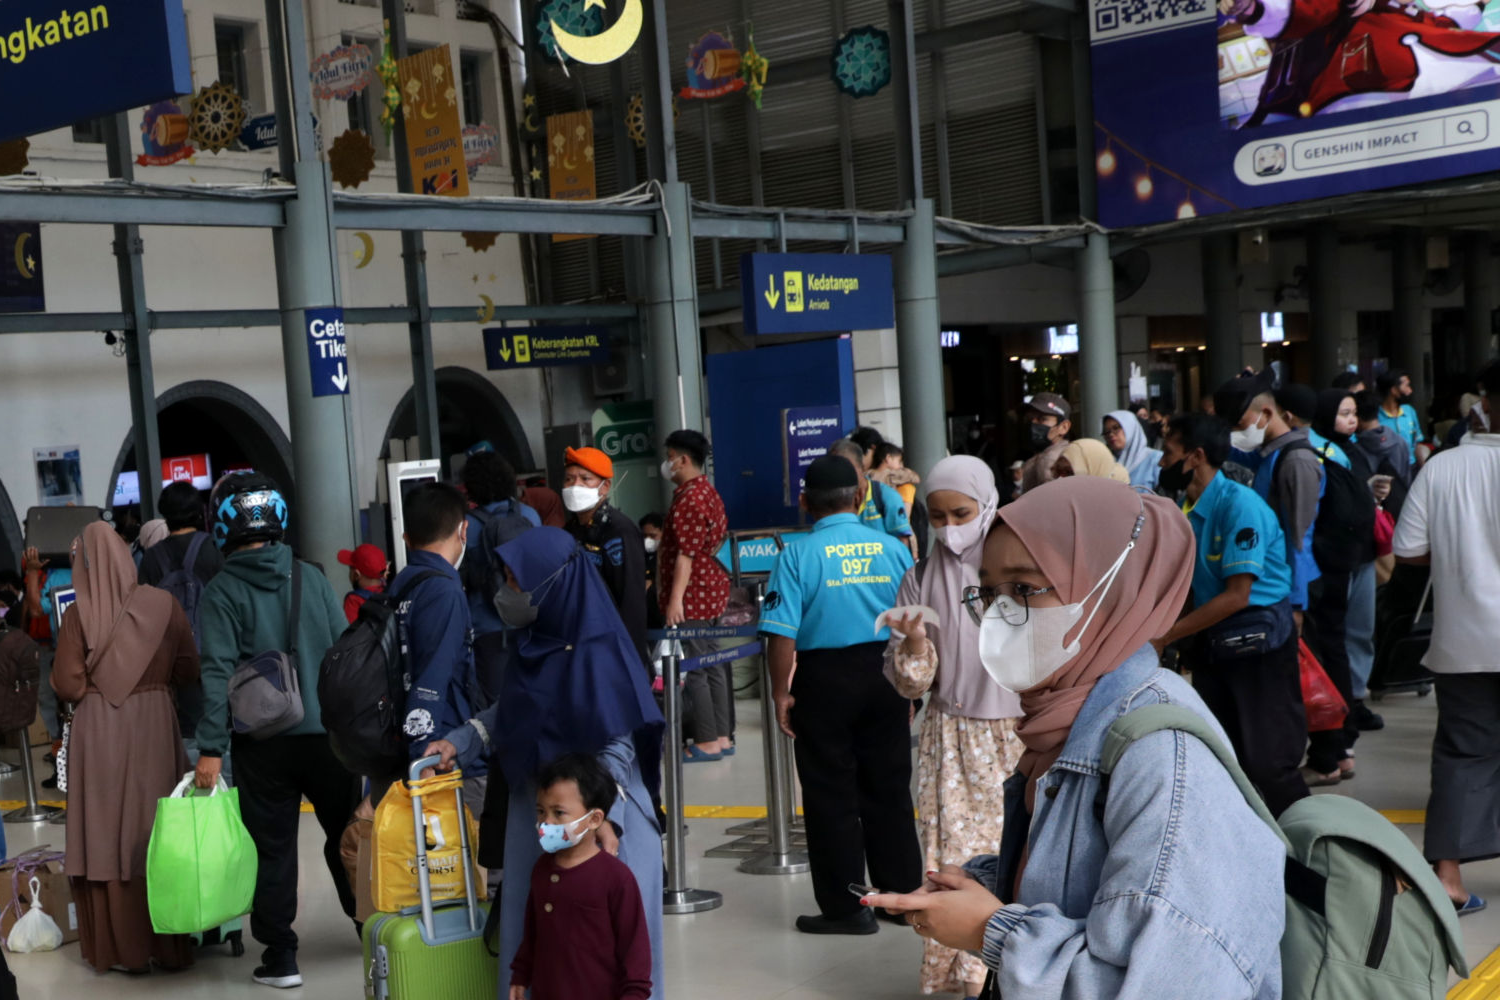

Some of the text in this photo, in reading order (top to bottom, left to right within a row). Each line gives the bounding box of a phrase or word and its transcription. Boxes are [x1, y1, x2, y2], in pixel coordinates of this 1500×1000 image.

[1303, 131, 1419, 160] GENSHIN IMPACT
[807, 273, 859, 295] Kedatangan
[309, 318, 345, 338] Ceta
[315, 338, 347, 359] Tike
[532, 335, 585, 351] Keberangkatan
[825, 542, 884, 559] PORTER
[841, 557, 873, 575] 097
[666, 629, 678, 638] PT
[680, 628, 696, 638] KAI
